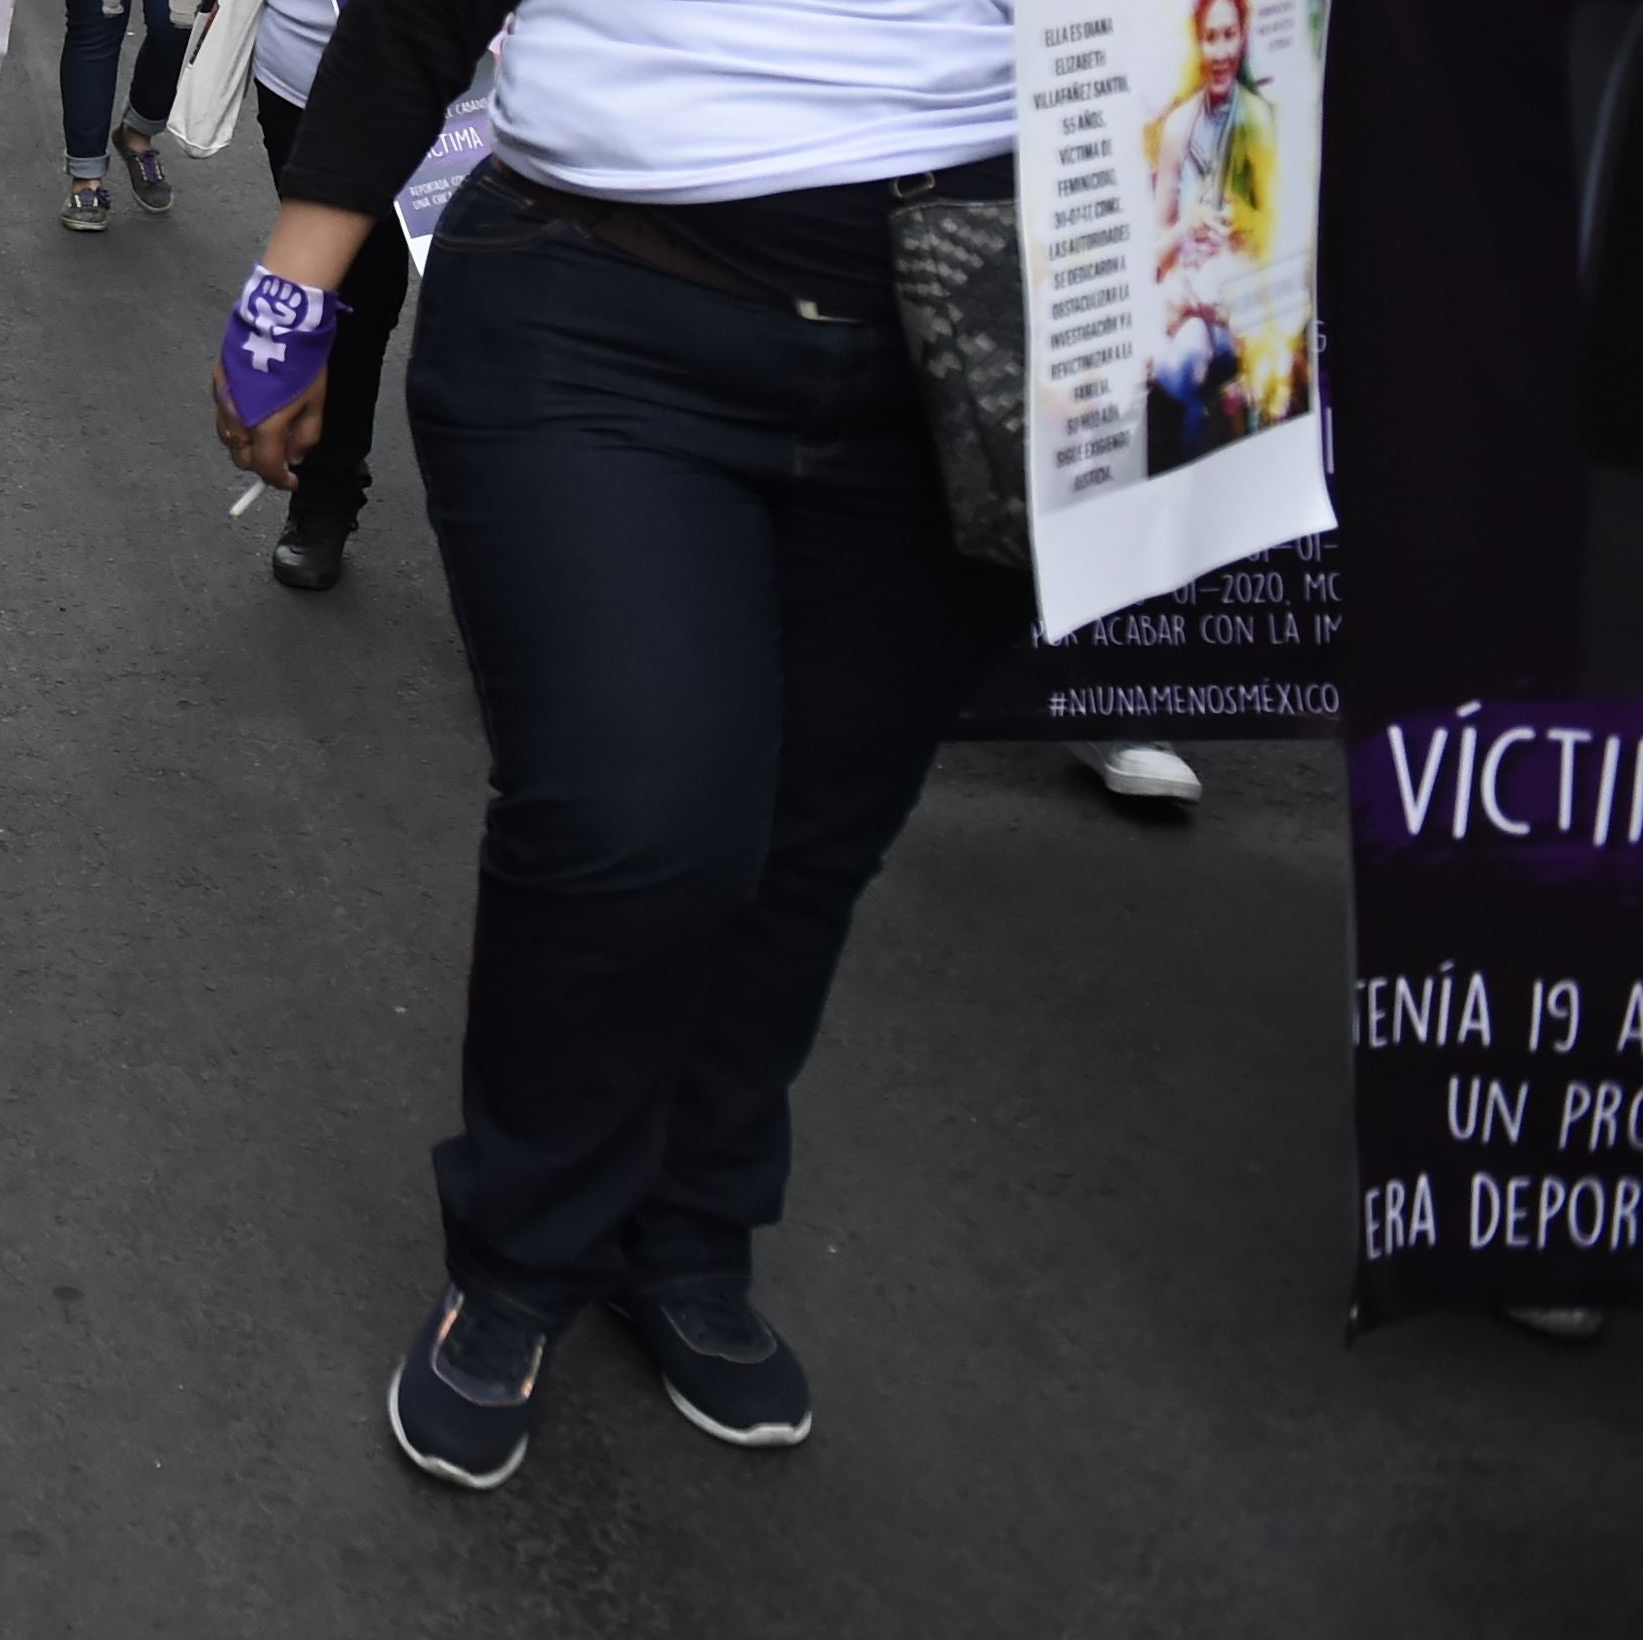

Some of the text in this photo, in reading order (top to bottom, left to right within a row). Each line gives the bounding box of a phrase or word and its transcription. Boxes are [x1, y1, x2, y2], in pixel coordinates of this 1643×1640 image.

[1093, 613, 1186, 647] ACABAR
[1199, 614, 1255, 645] CON
[1268, 613, 1301, 646] LA
[1049, 677, 1341, 718] #NIUNAMENOSMÉXICO
[1528, 978, 1581, 1054] 19
[1446, 1075, 1528, 1146] UN
[1365, 1172, 1643, 1262] ERA DEPOR
